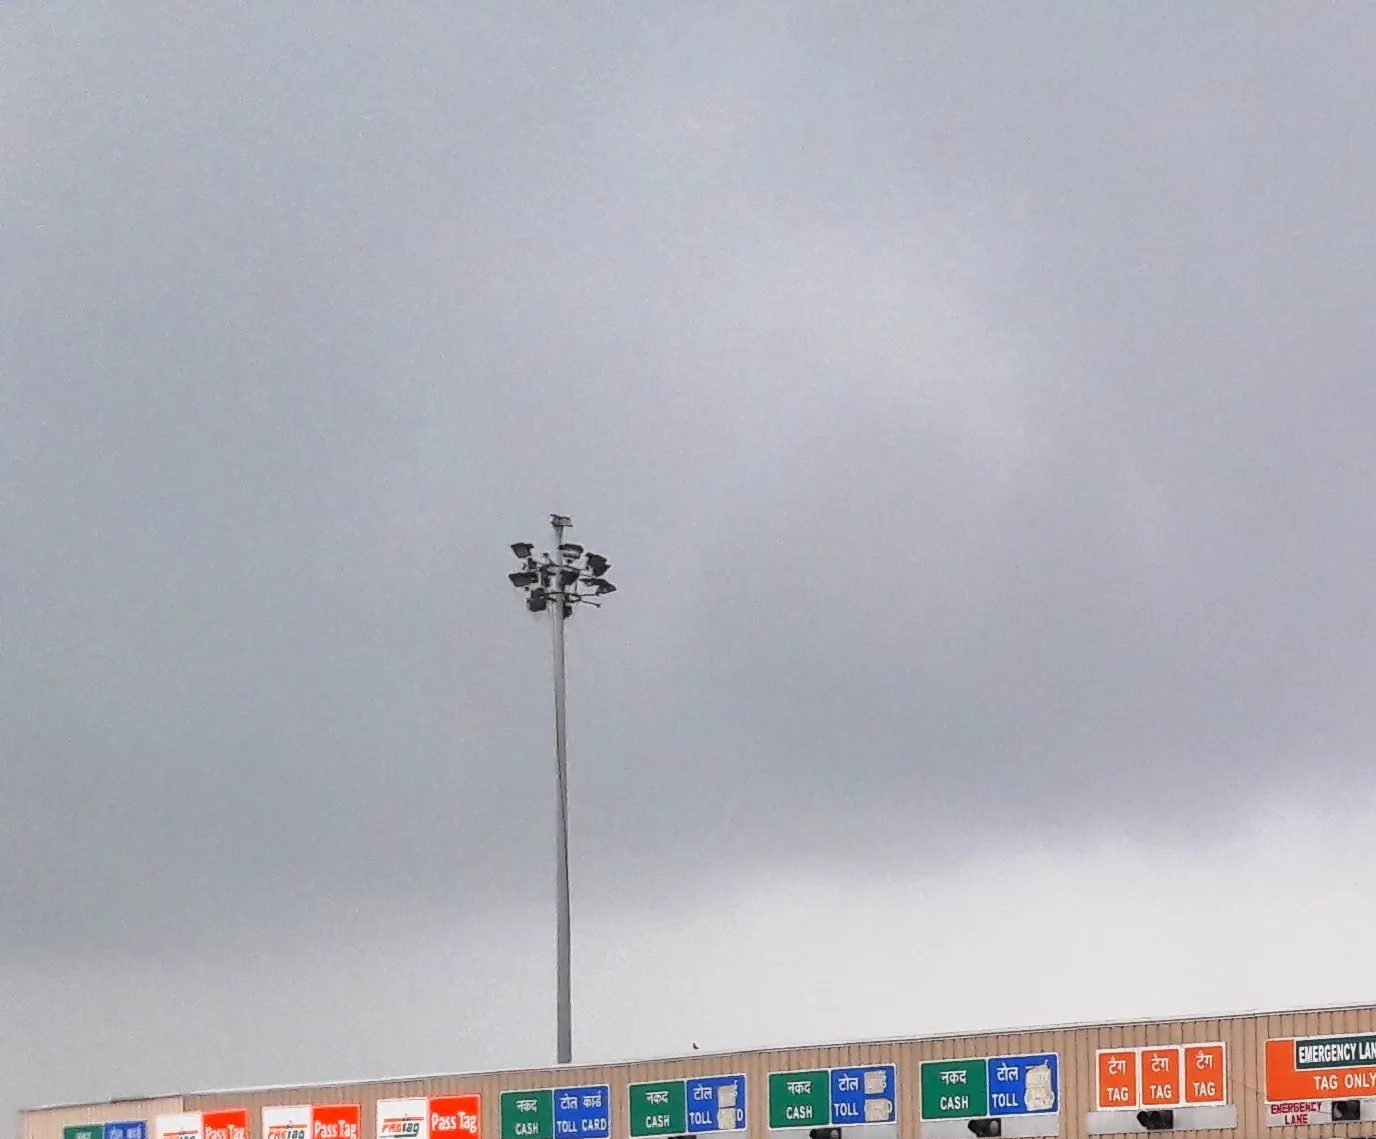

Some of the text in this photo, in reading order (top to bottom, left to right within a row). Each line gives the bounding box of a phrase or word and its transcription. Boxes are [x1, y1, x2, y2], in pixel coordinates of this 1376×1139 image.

[1299, 1042, 1357, 1063] EMERGENCY
[940, 1068, 967, 1085] नकद
[996, 1062, 1019, 1081] टोल
[787, 1079, 812, 1095] नकद
[838, 1073, 858, 1091] टोल
[1193, 1081, 1215, 1097] TAG
[1314, 1072, 1376, 1091] TAG ONLY
[693, 1082, 712, 1100] टोल
[1106, 1087, 1128, 1101] TAG
[1149, 1084, 1172, 1099] TAG
[560, 1093, 578, 1110] टोल
[940, 1095, 969, 1110] CASH
[992, 1092, 1019, 1108] TOLL
[786, 1105, 813, 1120] CASH
[834, 1102, 859, 1116] TOLL
[432, 1111, 478, 1133] Pass Tag
[556, 1118, 607, 1133] TOLL CARD
[646, 1115, 670, 1128] CASH
[689, 1111, 712, 1125] TOLL
[1285, 1114, 1308, 1125] LANE
[314, 1120, 337, 1138] Pass
[515, 1122, 539, 1135] CASH
